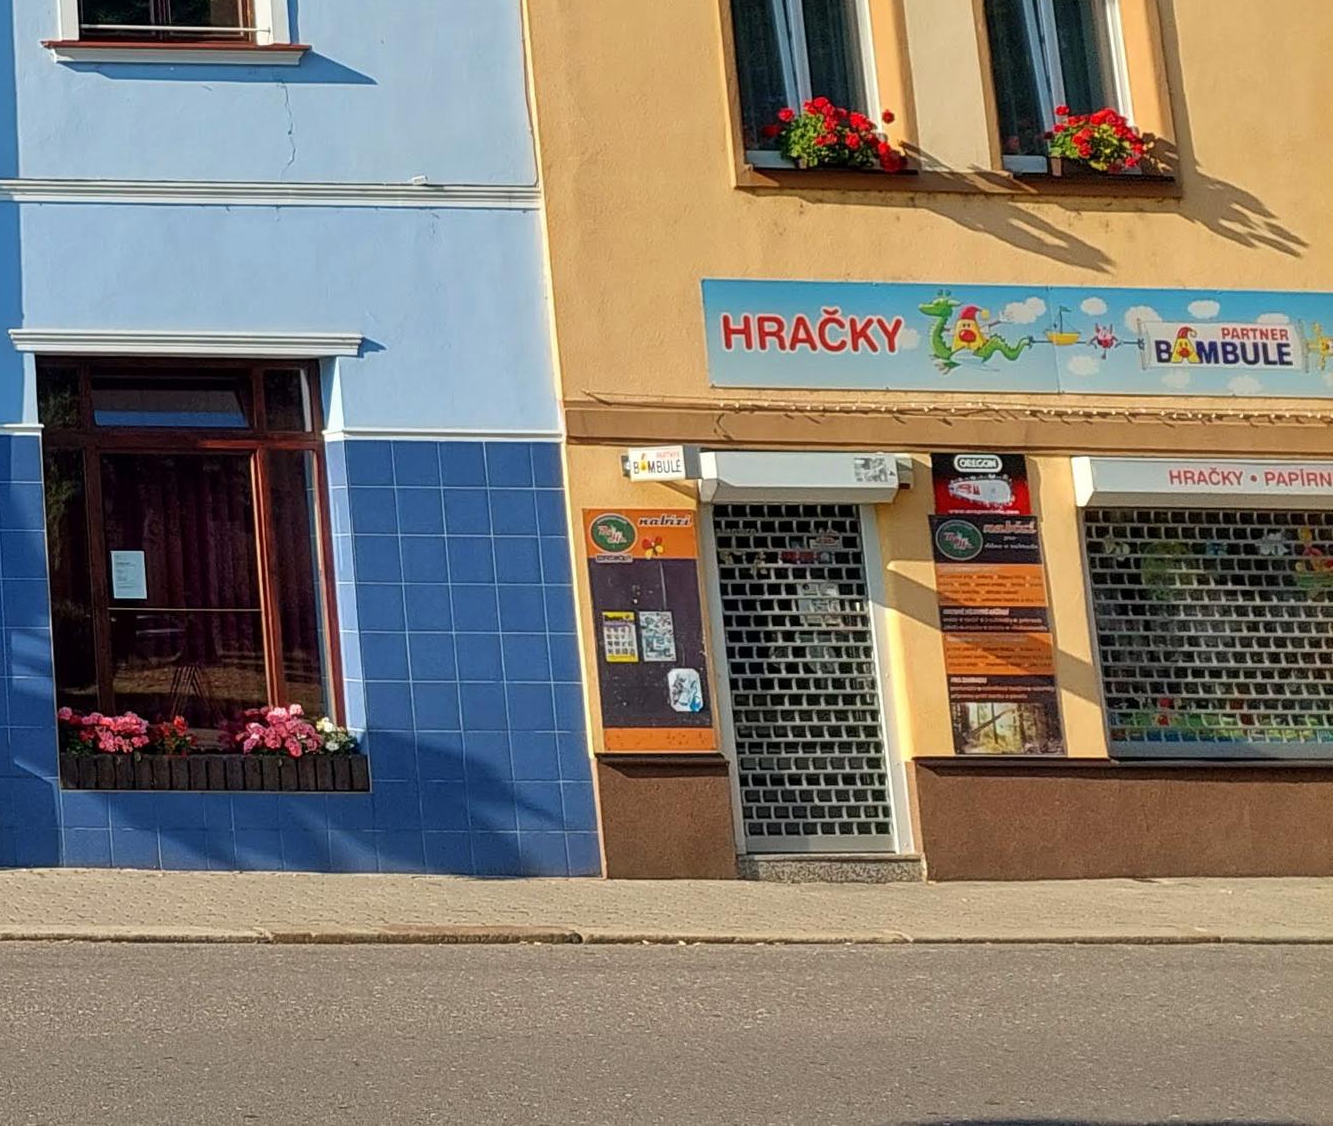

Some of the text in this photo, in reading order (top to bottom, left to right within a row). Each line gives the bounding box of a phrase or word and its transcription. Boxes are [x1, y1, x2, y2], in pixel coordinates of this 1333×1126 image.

[720, 306, 904, 354] HRAČKY
[1220, 327, 1289, 341] PARTNER
[1155, 337, 1293, 366] BAMBULE
[633, 459, 683, 474] BAMBULE
[959, 458, 997, 468] OREGON
[1169, 466, 1333, 487] HRAČKY PAPÍRN
